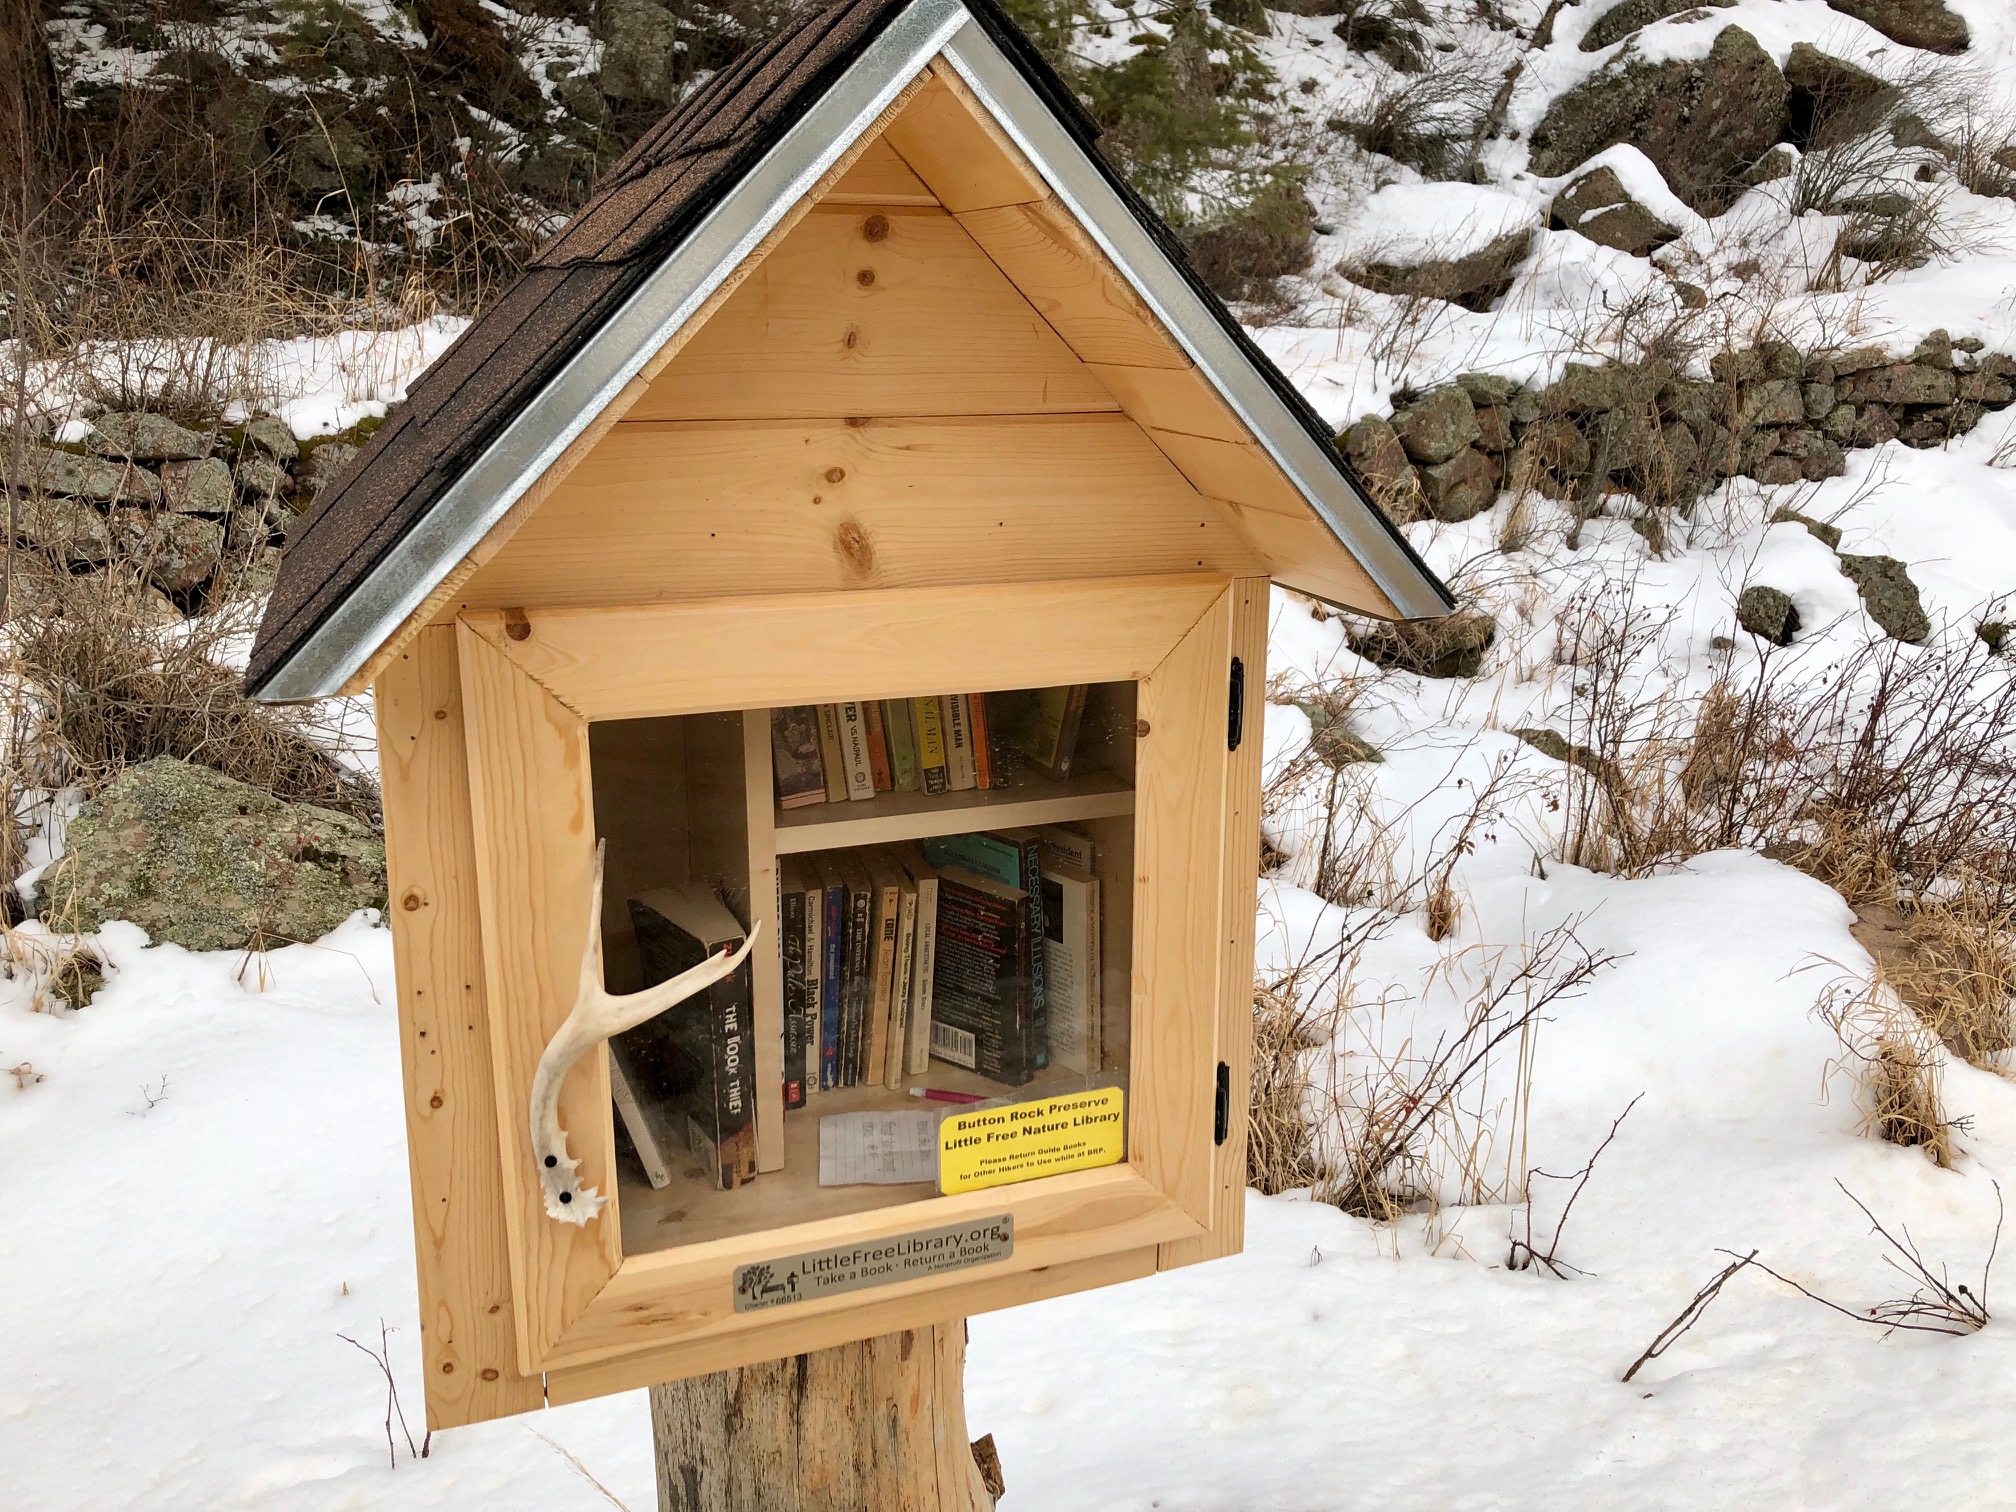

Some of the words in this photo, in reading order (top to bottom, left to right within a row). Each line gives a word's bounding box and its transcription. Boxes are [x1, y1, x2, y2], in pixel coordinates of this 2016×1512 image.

[953, 728, 964, 749] MAN
[1027, 844, 1042, 933] NECESSARY
[807, 896, 815, 935] Carmichael
[806, 945, 815, 976] Hamilton
[1031, 935, 1045, 1009] ILLUSIONS
[806, 978, 818, 1009] Black
[724, 1004, 738, 1033] THE
[805, 1012, 818, 1046] Power
[729, 1078, 742, 1116] THIEF
[957, 1115, 1006, 1131] Button
[1010, 1107, 1045, 1122] Rock
[1048, 1096, 1110, 1115] Preserve
[944, 1134, 982, 1151] Little
[986, 1130, 1018, 1143] Free
[1022, 1120, 1069, 1137] Nature
[1073, 1110, 1121, 1128] Library
[959, 1172, 972, 1181] for
[973, 1167, 996, 1178] Other
[998, 1163, 1024, 1174] Hikers
[1026, 1160, 1035, 1168] to
[1037, 1157, 1052, 1166] Use
[1054, 1152, 1076, 1163] while
[1077, 1151, 1085, 1159] at
[1087, 1147, 1107, 1157] BRP.
[979, 1155, 1007, 1167] Please
[1008, 1151, 1036, 1161] Return
[1037, 1145, 1061, 1156] Guide
[1063, 1140, 1088, 1151] Books
[801, 1224, 1001, 1275] LittleFreeLibrary.org
[814, 1270, 846, 1287] Take
[849, 1270, 857, 1280] a
[860, 1262, 893, 1278] Book
[903, 1252, 945, 1269] Return
[949, 1250, 956, 1259] a
[959, 1241, 990, 1257] Book
[963, 1250, 1002, 1264] Organization
